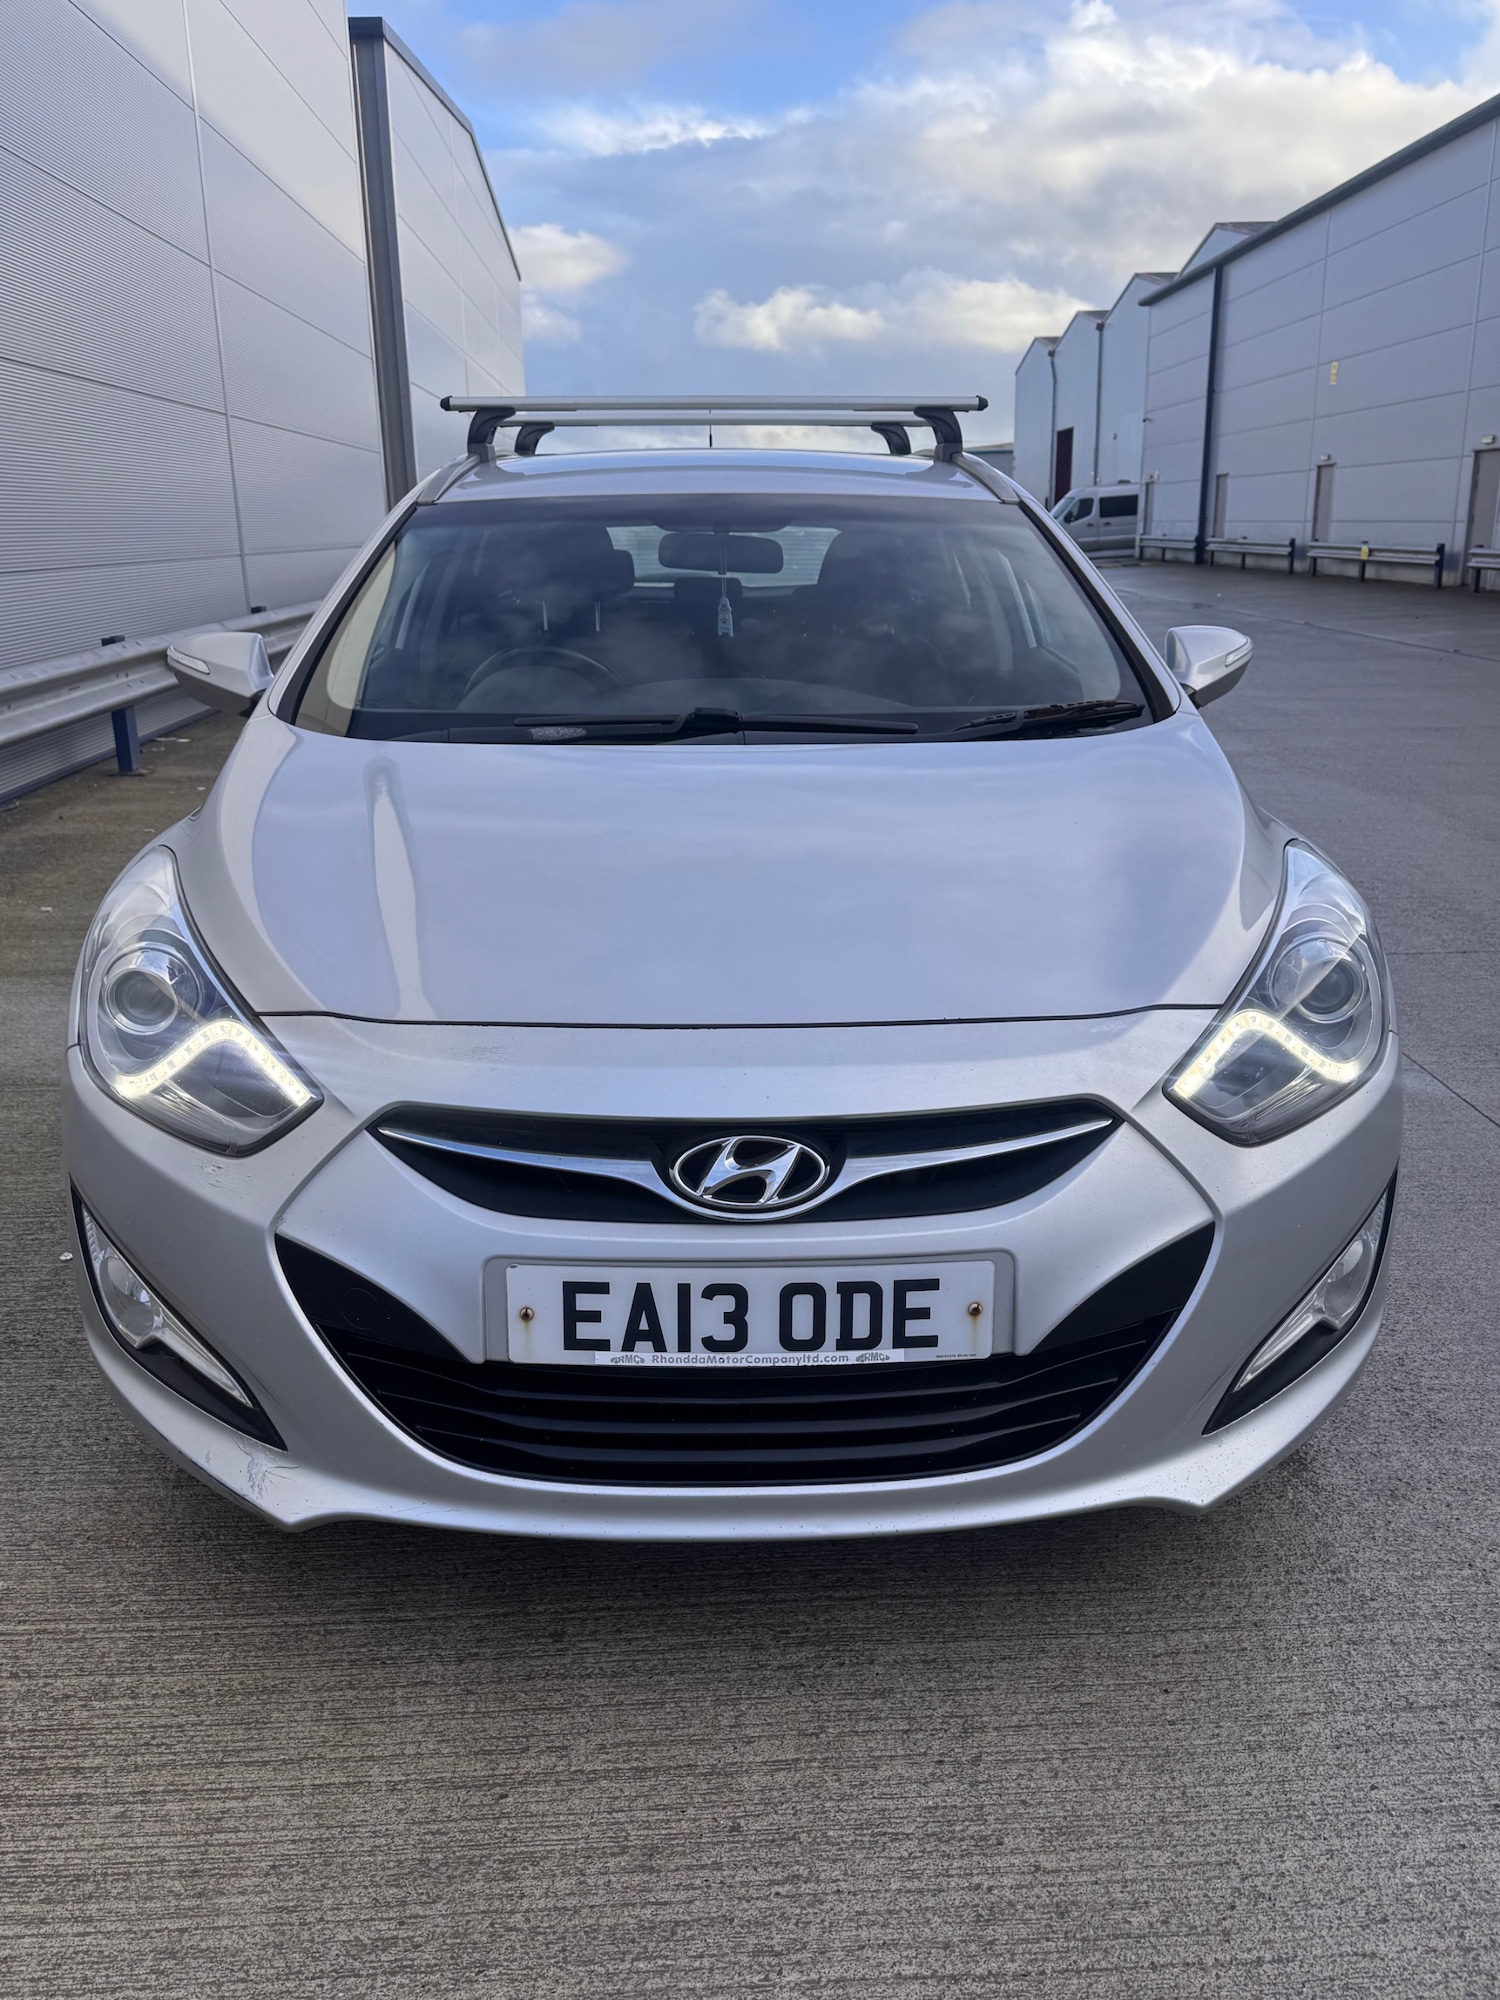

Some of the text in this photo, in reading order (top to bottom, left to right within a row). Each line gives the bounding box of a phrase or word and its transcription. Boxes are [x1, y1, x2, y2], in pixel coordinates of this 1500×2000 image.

[562, 1278, 940, 1353] EA13 ODE
[651, 1353, 849, 1366] RhonddaMotorCompanyltd.com
